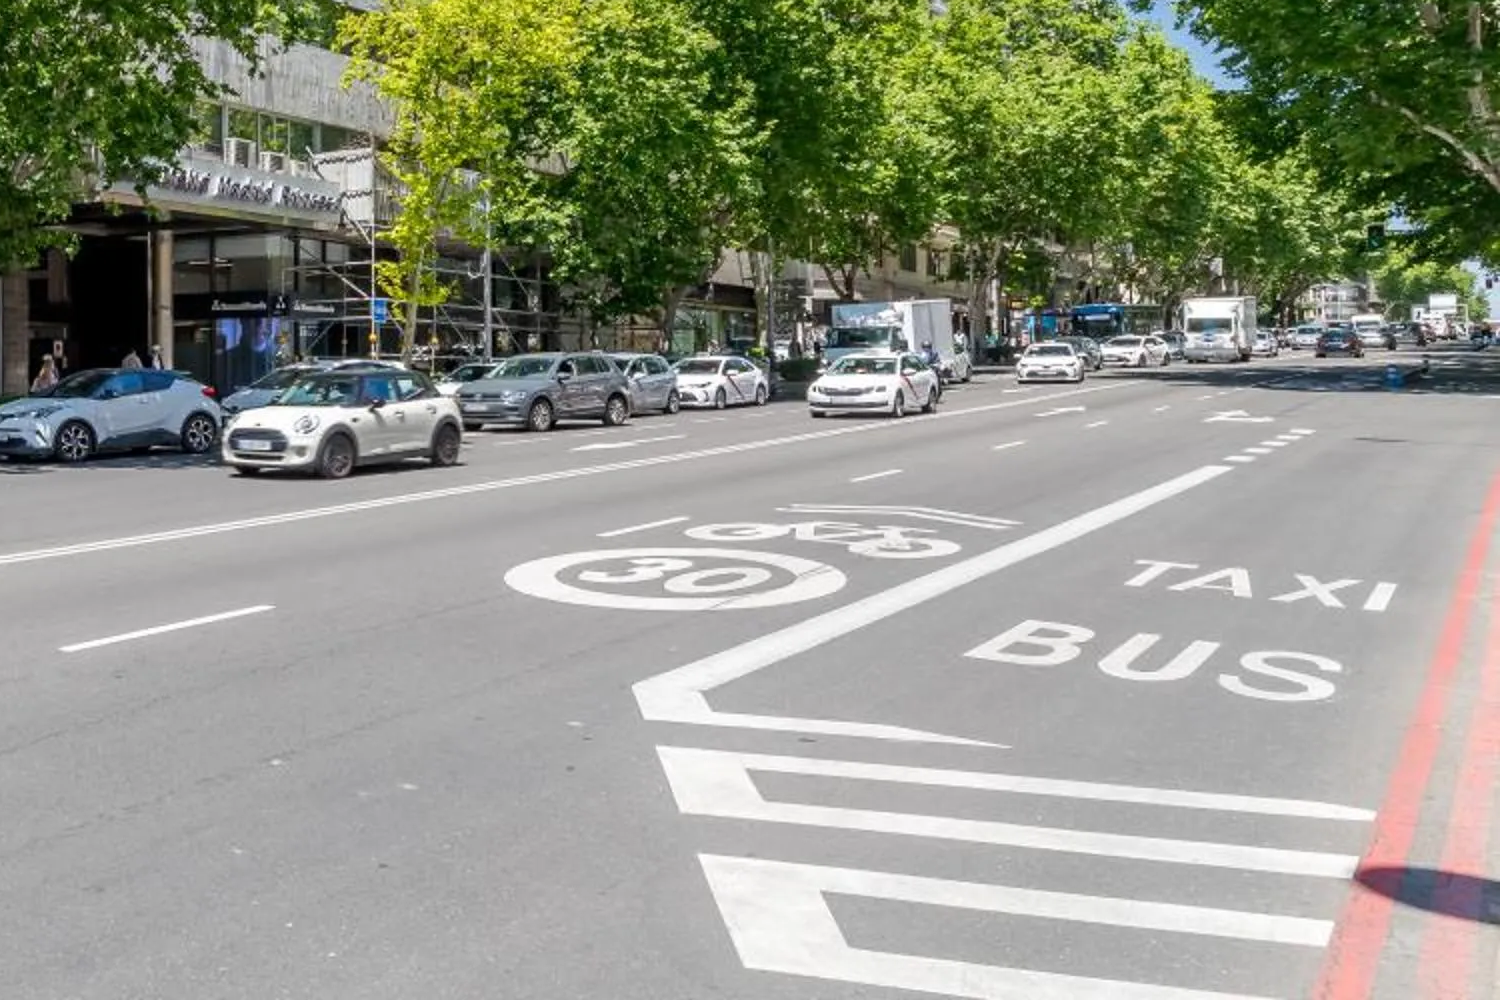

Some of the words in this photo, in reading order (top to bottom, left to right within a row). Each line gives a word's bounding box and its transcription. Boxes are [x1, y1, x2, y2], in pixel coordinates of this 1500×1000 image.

[577, 557, 772, 595] 30
[1122, 559, 1399, 612] TAXI
[963, 619, 1343, 702] BUS
